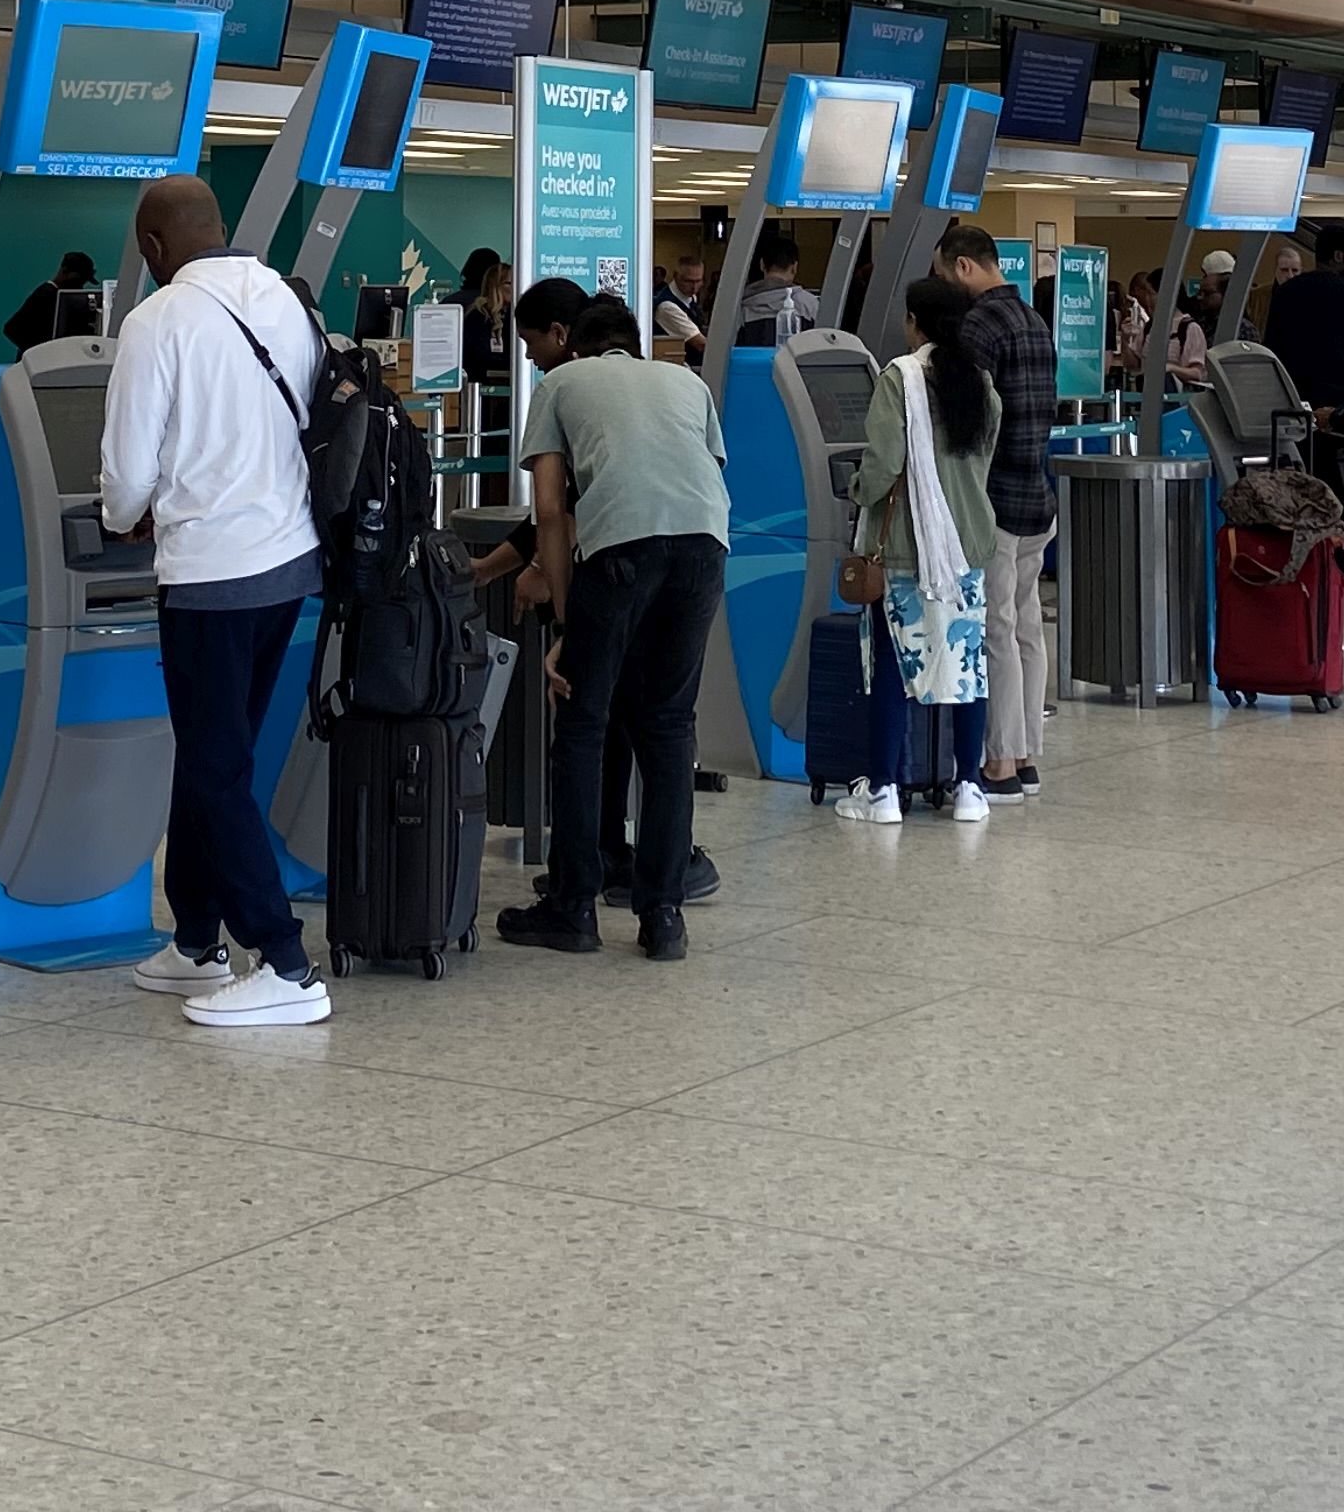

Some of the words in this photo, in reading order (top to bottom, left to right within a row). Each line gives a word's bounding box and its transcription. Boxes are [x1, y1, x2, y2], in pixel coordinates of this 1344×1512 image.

[224, 20, 247, 36] ages
[872, 22, 915, 46] WESTJET
[60, 79, 153, 106] WESTJET
[542, 82, 611, 118] WESTJET
[38, 153, 84, 163] EDMONTON
[86, 155, 145, 165] INTERNATIONAL
[147, 157, 178, 166] AIRPORT
[542, 145, 575, 168] Have
[578, 152, 601, 174] you
[114, 165, 168, 179] CHECK-IN
[541, 173, 595, 197] checked
[597, 176, 616, 198] in?
[541, 204, 579, 219] Avez-vous
[541, 224, 561, 237] votre
[998, 257, 1017, 274] STJET
